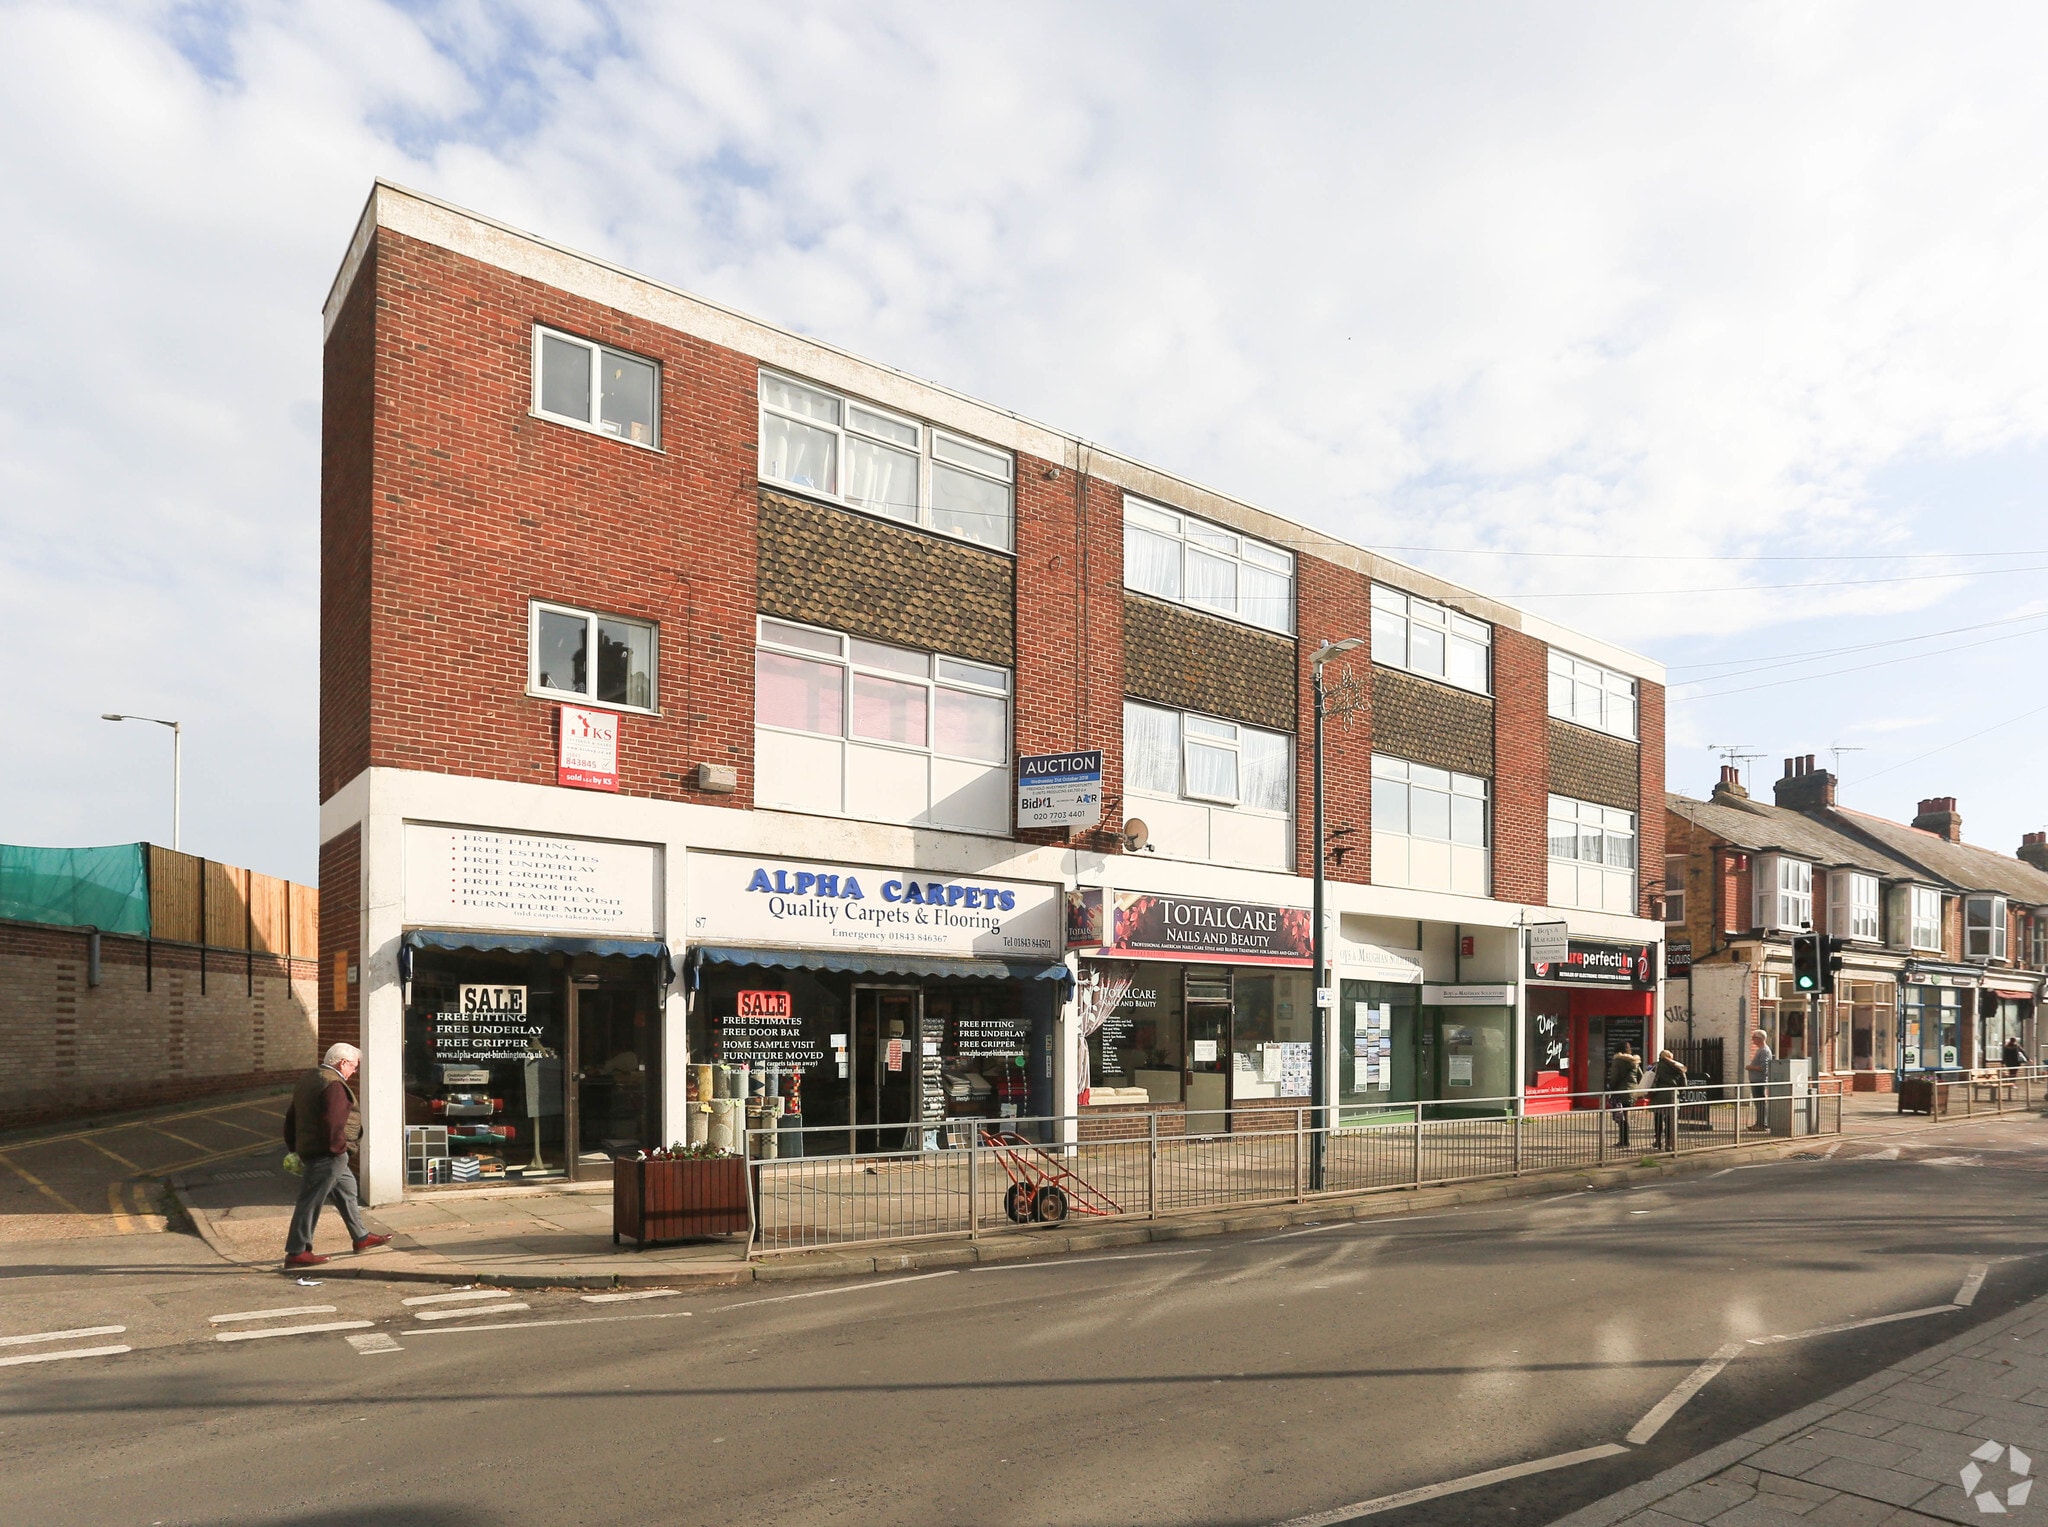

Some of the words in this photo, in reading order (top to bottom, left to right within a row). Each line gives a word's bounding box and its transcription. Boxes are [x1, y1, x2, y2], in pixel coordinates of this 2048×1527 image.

[593, 727, 612, 740] KS
[566, 758, 596, 768] 843845
[1026, 756, 1094, 774] AUCTION
[593, 776, 602, 784] by
[1068, 810, 1085, 818] 4401
[464, 834, 503, 844] FREE
[509, 839, 576, 850] FITTING
[464, 846, 503, 854] FREE
[510, 850, 599, 863] ESTIMATES
[464, 856, 503, 865] FREE
[510, 860, 597, 872] UNDERLAY
[464, 867, 503, 876] FREE
[508, 870, 578, 882] GRIPPER
[464, 878, 503, 886] FREE
[510, 882, 558, 891] DOOR
[564, 885, 595, 893] BAR
[746, 868, 864, 900] ALPHA
[881, 880, 1016, 911] CARPETS
[464, 888, 513, 898] HOME
[518, 892, 580, 902] SAMPLE
[584, 897, 624, 906] VISIT
[464, 899, 559, 912] FURNITURE
[564, 906, 623, 916] MOVED
[769, 896, 839, 924] Quality
[845, 901, 909, 928] Carpets
[915, 910, 928, 925] &
[934, 908, 1000, 934] Flooring
[533, 912, 563, 920] carpets
[695, 916, 706, 929] 87
[1159, 899, 1277, 932] TOTALCARE
[832, 928, 886, 942] Emergency
[888, 931, 915, 942] 01843
[917, 932, 948, 943] 846367
[1003, 936, 1013, 948] Tel
[1014, 936, 1030, 948] 01843
[1031, 938, 1051, 949] 844501
[1167, 928, 1200, 943] NAILS
[1202, 932, 1227, 944] AND
[1231, 932, 1270, 947] BEAUTY
[464, 988, 523, 1014] SALE
[742, 994, 786, 1016] SALE
[436, 1013, 469, 1021] FREE
[472, 1014, 527, 1022] FITTING
[723, 1016, 747, 1024] FREE
[436, 1026, 469, 1034] FREE
[472, 1026, 544, 1035] UNDERLAY
[723, 1028, 746, 1036] FREE
[749, 1028, 778, 1036] DOOR
[436, 1039, 469, 1047] FREE
[472, 1039, 528, 1047] GRIPPER
[436, 1050, 542, 1061] www.alpha-carpet-birchington.co.uk
[723, 1052, 783, 1060] FURNITURE
[786, 1052, 824, 1060] MOVED
